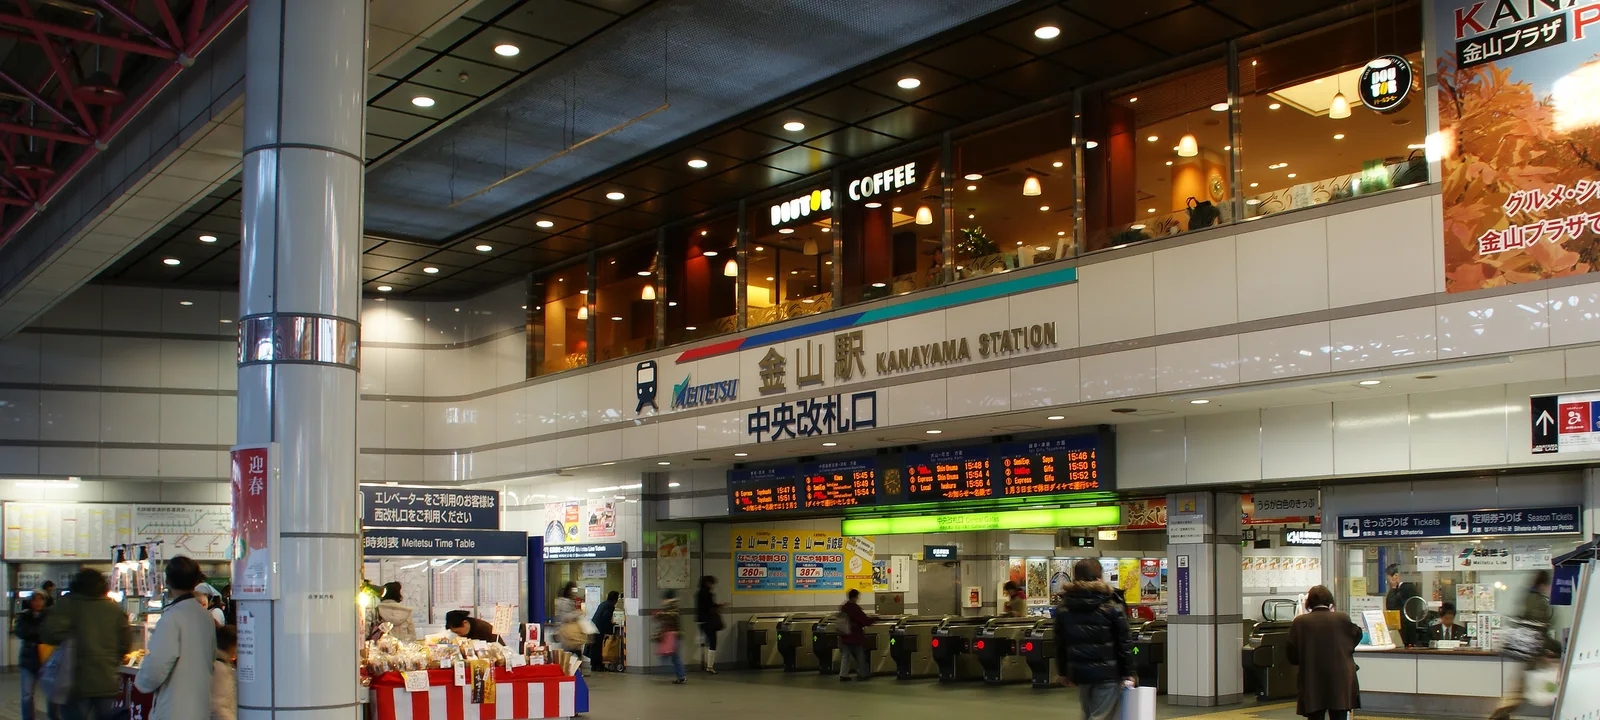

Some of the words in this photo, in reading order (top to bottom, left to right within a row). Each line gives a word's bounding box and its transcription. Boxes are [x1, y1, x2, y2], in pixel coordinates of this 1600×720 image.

[1463, 19, 1562, 64] 金山プラザ
[770, 188, 832, 226] DOUTOR
[848, 162, 916, 200] COFFEE
[1503, 180, 1600, 217] グルメ・シ
[876, 338, 971, 374] KANAYAMA
[978, 322, 1058, 358] STATION
[758, 330, 866, 396] 金山駅
[670, 373, 739, 409] MEITETSU
[748, 391, 877, 443] 中央改札口
[1068, 452, 1088, 461] 15:46
[1090, 451, 1096, 459] 4
[965, 461, 982, 470] 15:48
[984, 460, 990, 468] 6
[1068, 461, 1088, 470] 15:50
[1091, 460, 1096, 469] 6
[248, 456, 264, 496] 迎春
[853, 472, 868, 480] 15:45
[966, 470, 982, 479] 15:54
[1014, 476, 1032, 484] Express
[1069, 471, 1089, 480] 15:52
[1092, 470, 1096, 478] 6
[776, 486, 790, 494] 15:47
[854, 480, 868, 488] 15:49
[778, 494, 790, 502] 15:51
[854, 488, 869, 496] 15:54
[374, 492, 494, 508] エレベーターをご利用のお客様は
[1258, 498, 1315, 510] うらが白色のきっぷ
[374, 508, 472, 523] 西改札口をご利用ください
[1472, 512, 1522, 524] 定期券うりば
[1527, 514, 1550, 522] Season
[1552, 512, 1573, 520] Tickets
[1363, 517, 1408, 528] きっぷうりば
[1412, 518, 1440, 526] Tickets
[364, 536, 398, 548] 時刻表
[402, 538, 432, 548] Meitetsu
[434, 538, 454, 548] Time
[454, 538, 475, 548] Table
